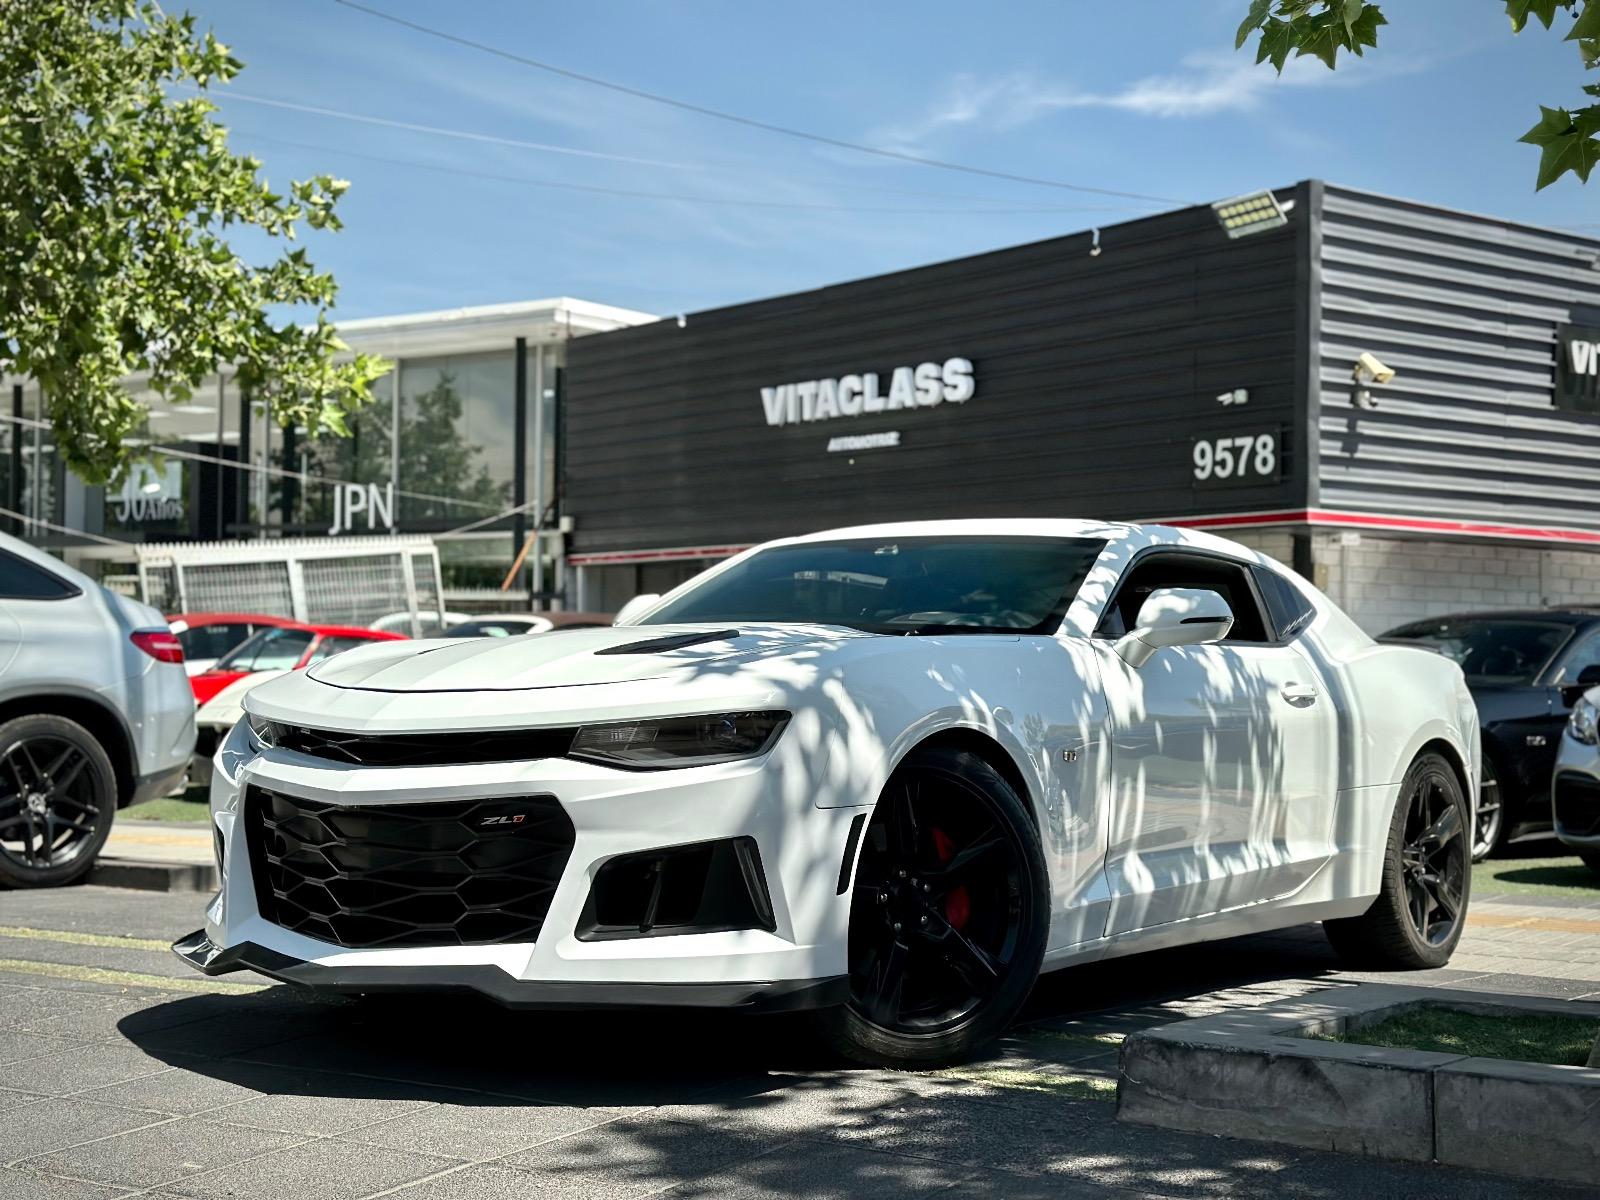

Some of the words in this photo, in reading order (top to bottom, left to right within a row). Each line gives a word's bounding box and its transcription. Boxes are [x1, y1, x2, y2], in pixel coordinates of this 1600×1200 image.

[1571, 339, 1600, 376] VI
[760, 357, 975, 426] VITACLASS
[1193, 434, 1275, 480] 9578
[328, 482, 393, 536] JPN
